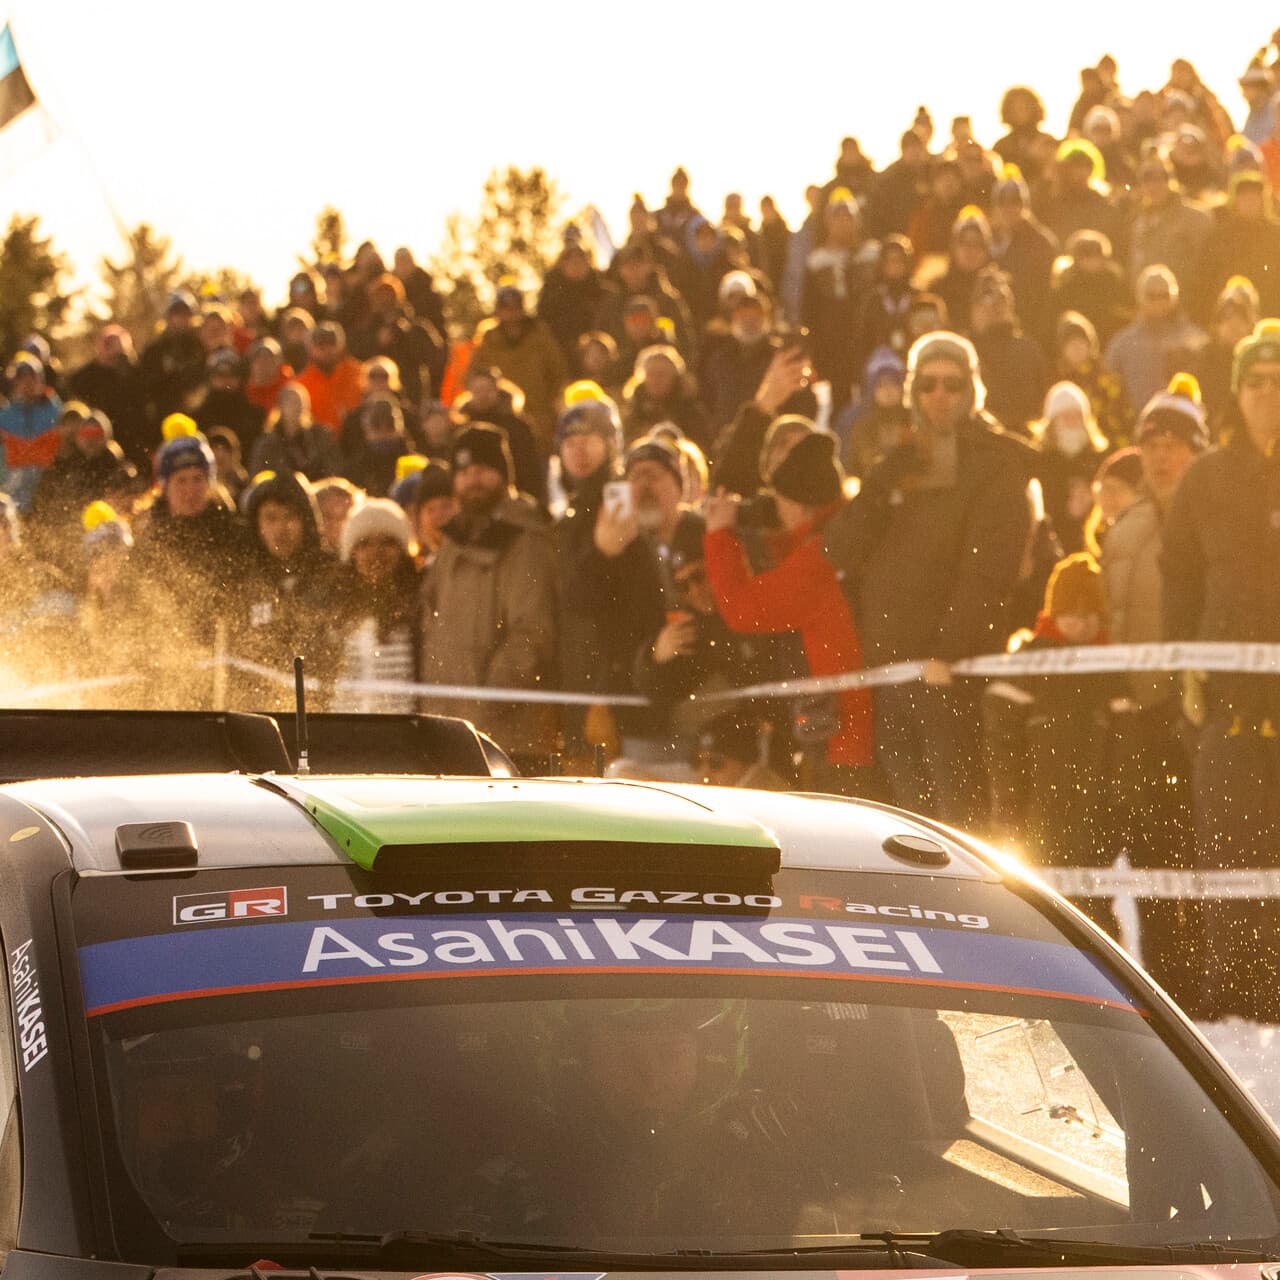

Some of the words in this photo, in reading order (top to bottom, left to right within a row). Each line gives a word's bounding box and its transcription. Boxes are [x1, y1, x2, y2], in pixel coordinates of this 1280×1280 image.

[179, 898, 282, 921] GR
[308, 887, 553, 910] TOYOTA
[570, 887, 783, 909] GAZOO
[801, 894, 991, 929] Racing
[302, 918, 945, 973] AsahiKASEI
[11, 938, 49, 1073] AsahiKASEI
